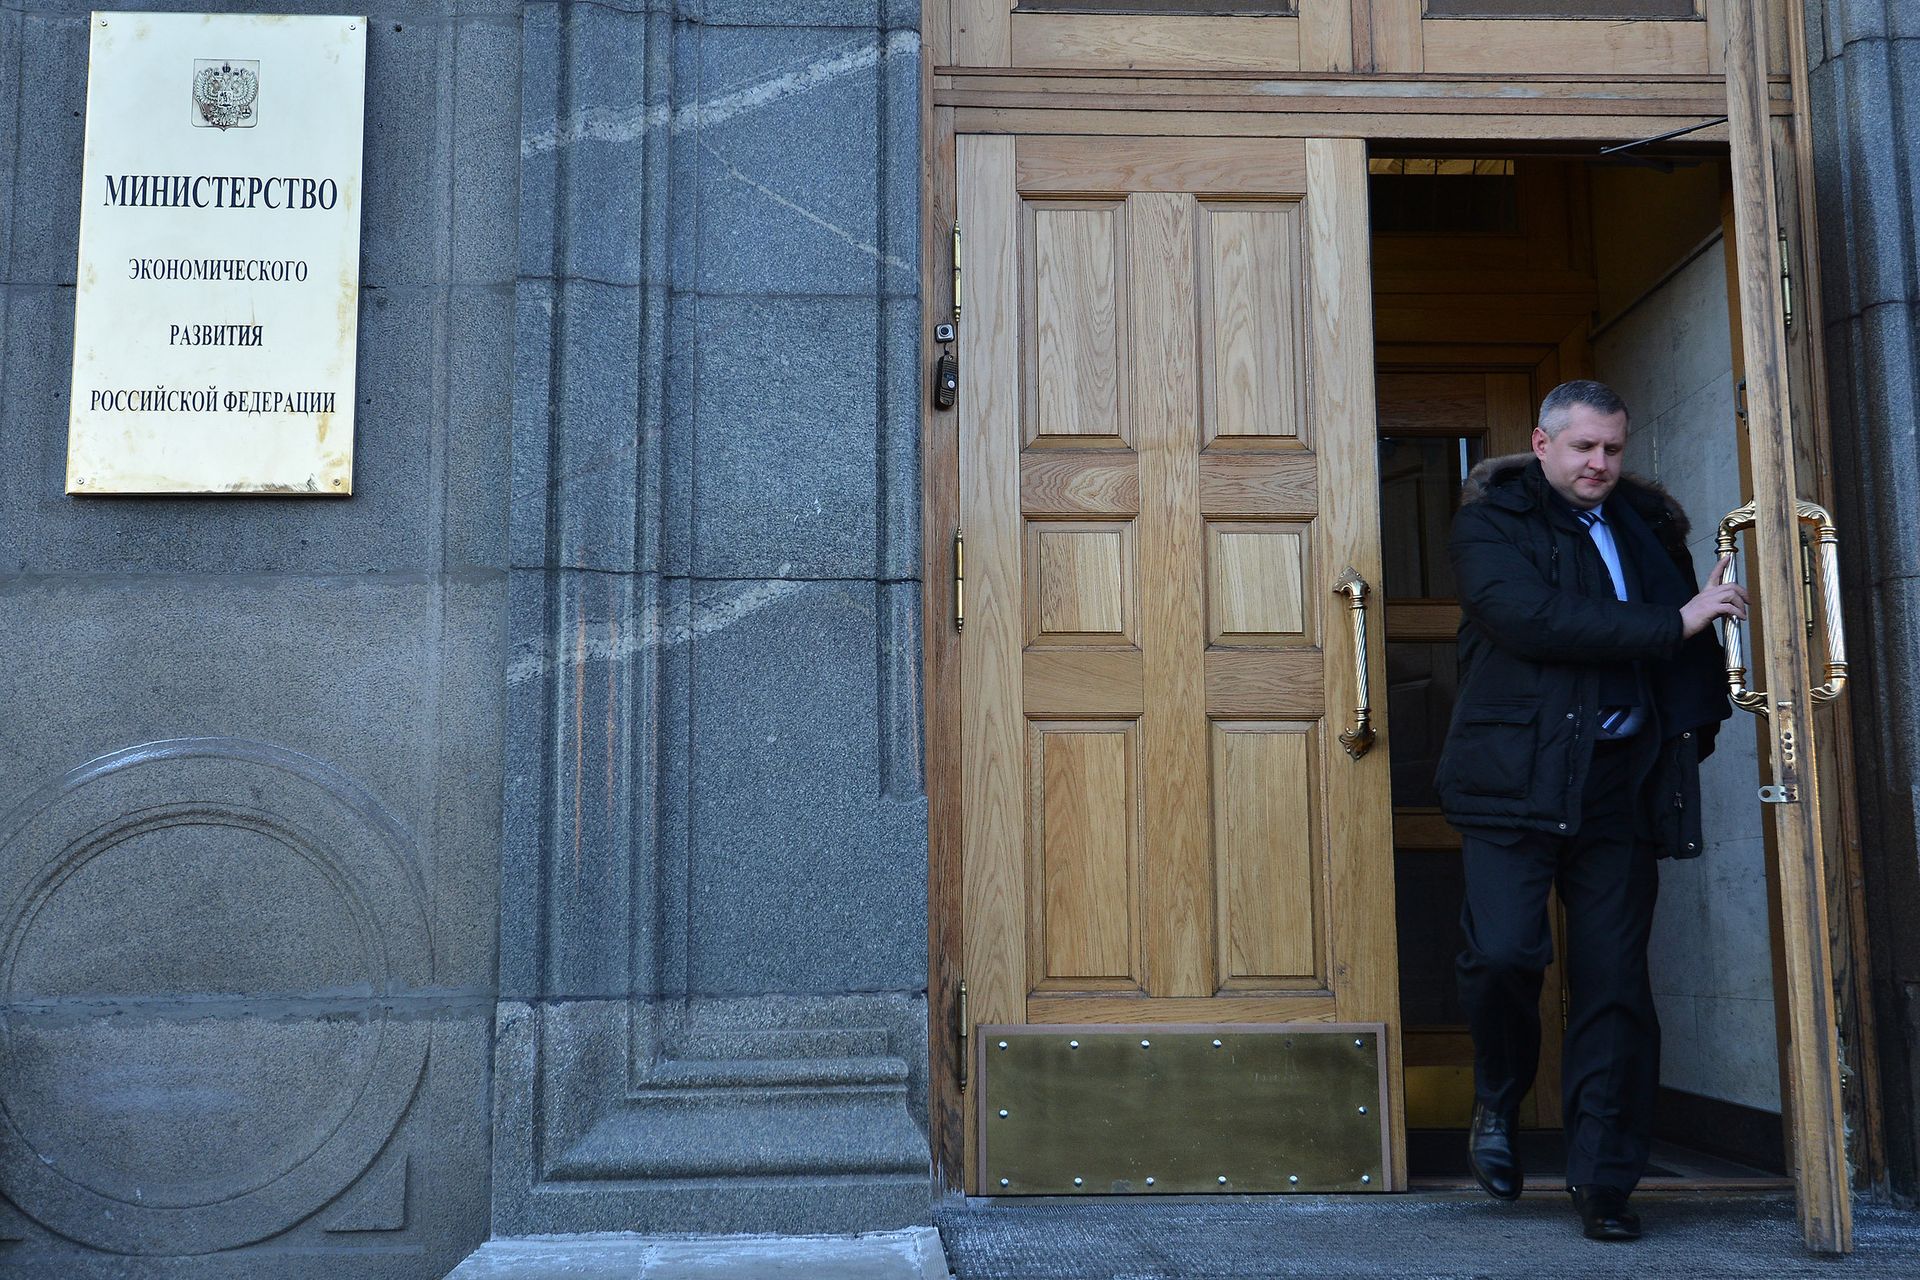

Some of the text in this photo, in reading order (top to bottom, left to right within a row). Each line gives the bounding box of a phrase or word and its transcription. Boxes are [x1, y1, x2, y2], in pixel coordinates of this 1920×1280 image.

[103, 174, 338, 210] МИНИСТЕРСТВО
[128, 258, 308, 282] ЭКОНОМИЧЕСКОГО
[169, 324, 263, 347] РАЗВИТИЯ
[90, 385, 336, 415] РОССИЙСКОЙ ФЕДЕРАЦИИ
